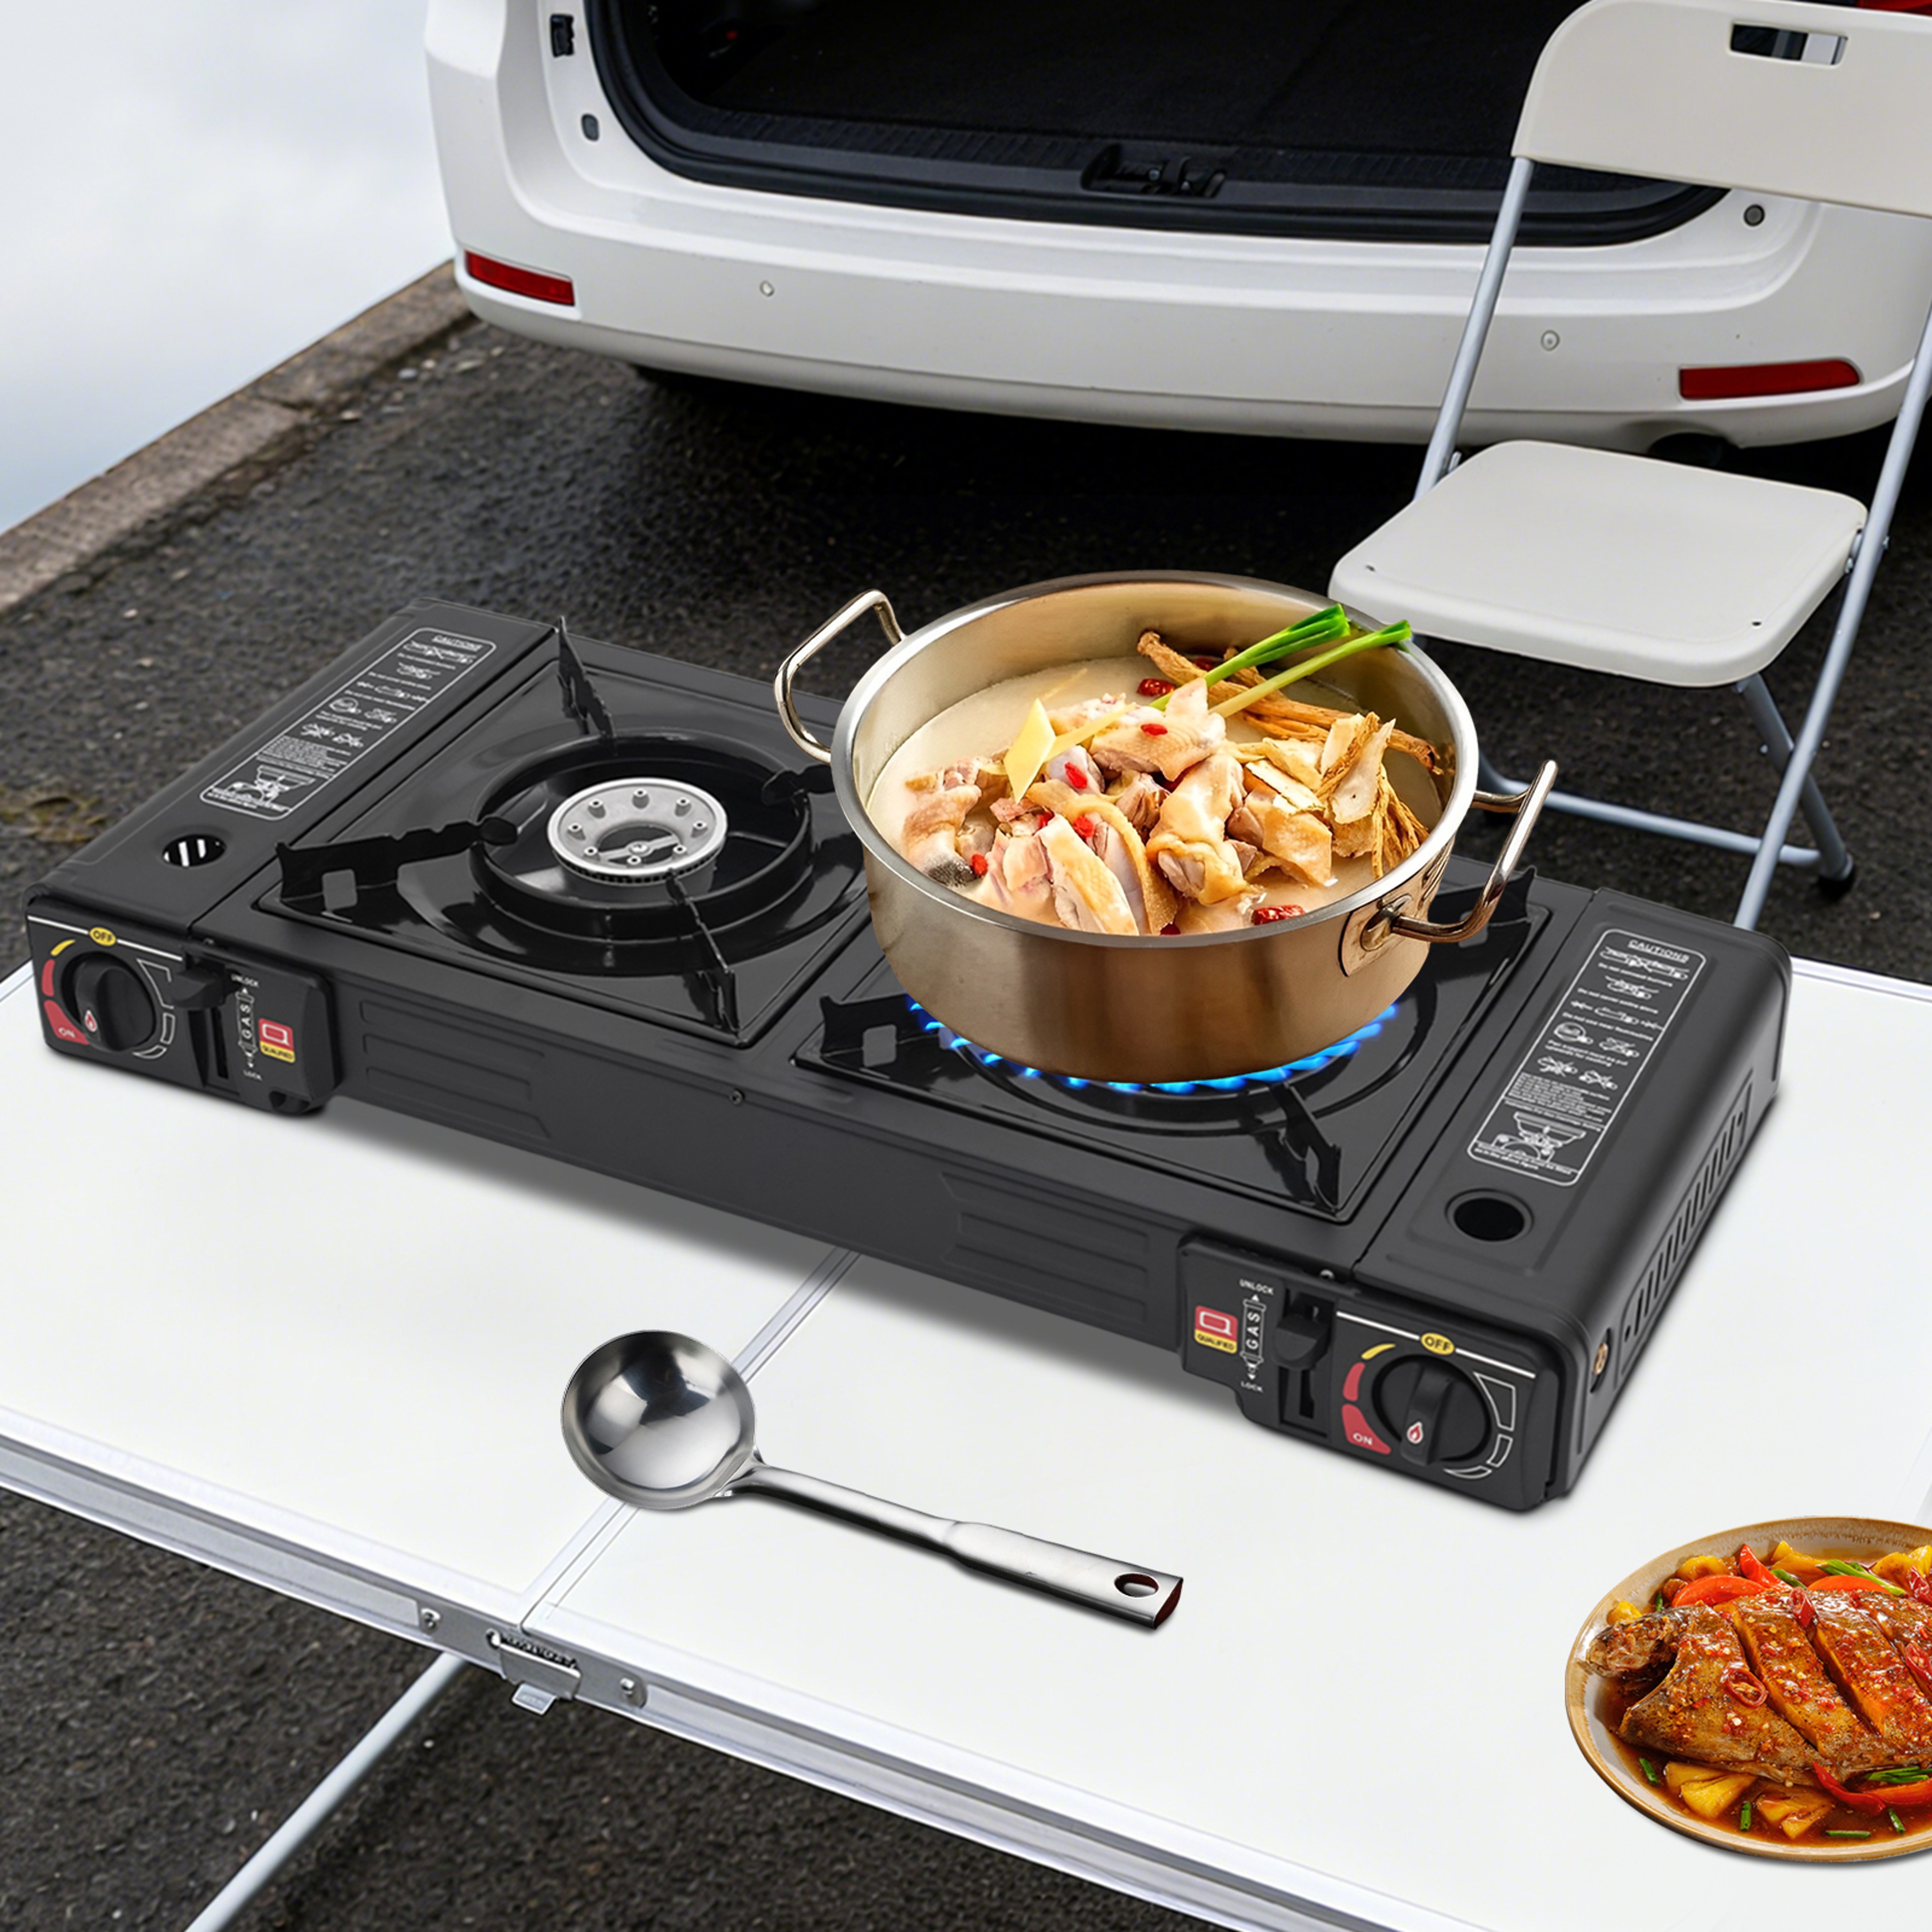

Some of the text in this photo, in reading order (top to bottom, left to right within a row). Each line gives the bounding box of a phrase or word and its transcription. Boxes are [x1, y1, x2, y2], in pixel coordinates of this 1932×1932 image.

[93, 930, 113, 942] OFF
[1627, 939, 1689, 963] CAUTIONS
[240, 1004, 252, 1039] GAS
[58, 1027, 75, 1038] ON
[1239, 1279, 1274, 1295] UNLOCK
[1246, 1312, 1260, 1349] GAS
[1197, 1333, 1235, 1351] QUALIFIED
[1425, 1336, 1452, 1351] OFF
[1241, 1381, 1264, 1393] LOCK
[1353, 1433, 1373, 1445] ON
